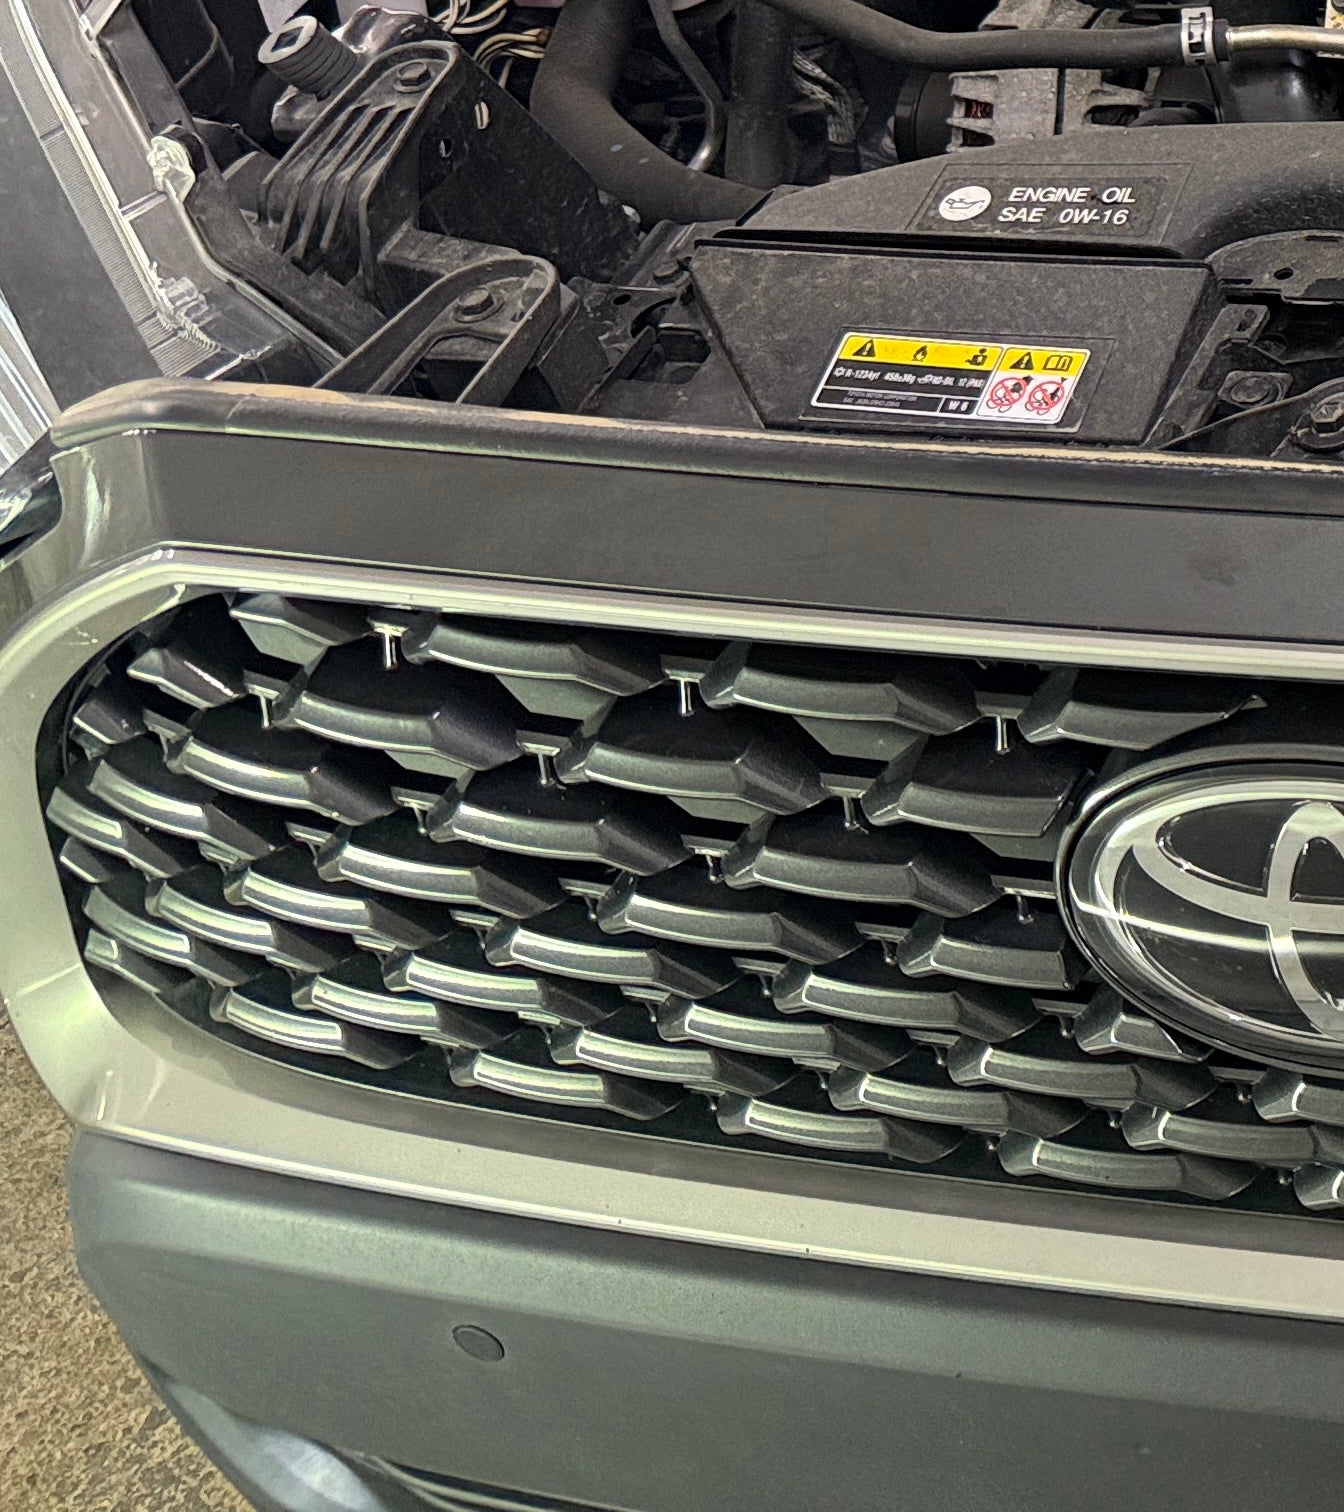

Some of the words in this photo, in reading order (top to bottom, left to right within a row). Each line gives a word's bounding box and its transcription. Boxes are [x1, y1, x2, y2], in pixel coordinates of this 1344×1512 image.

[1008, 187, 1091, 203] ENGINE
[1101, 187, 1136, 204] OIL
[998, 207, 1046, 223] SAE
[1059, 208, 1130, 225] 0W-16
